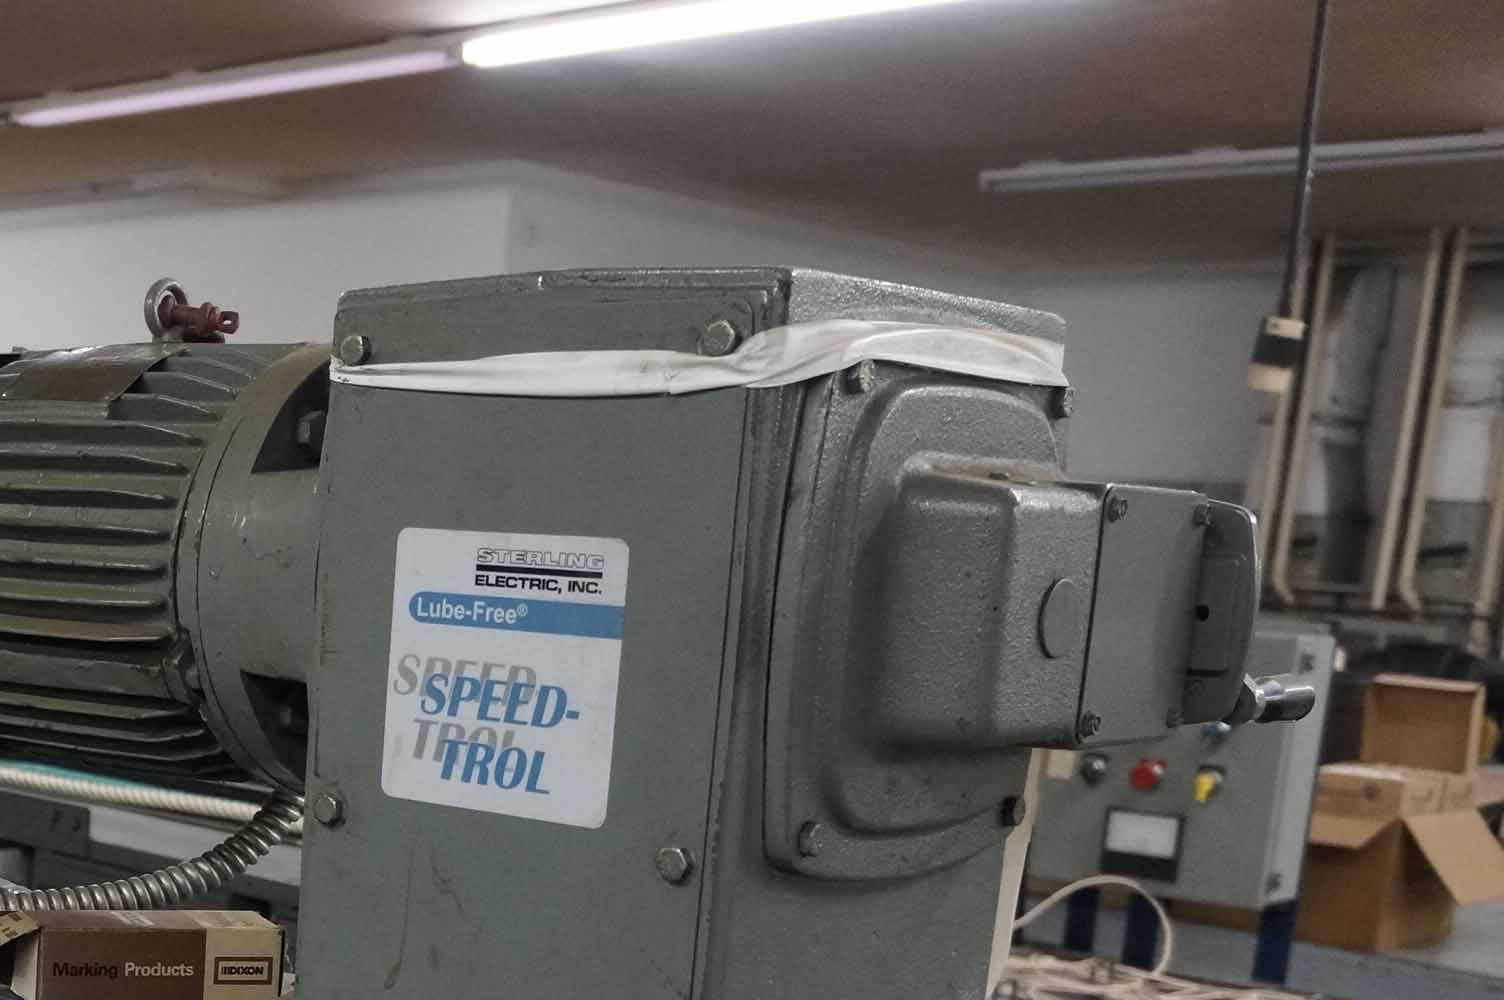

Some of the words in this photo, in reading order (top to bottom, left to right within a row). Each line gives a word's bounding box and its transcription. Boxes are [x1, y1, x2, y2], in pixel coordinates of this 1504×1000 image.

[476, 547, 605, 570] STERLING
[474, 574, 562, 595] ELECTRIC,
[566, 580, 603, 595] INC.
[439, 739, 551, 795] TROL
[53, 961, 119, 979] Marking
[124, 961, 195, 977] Products
